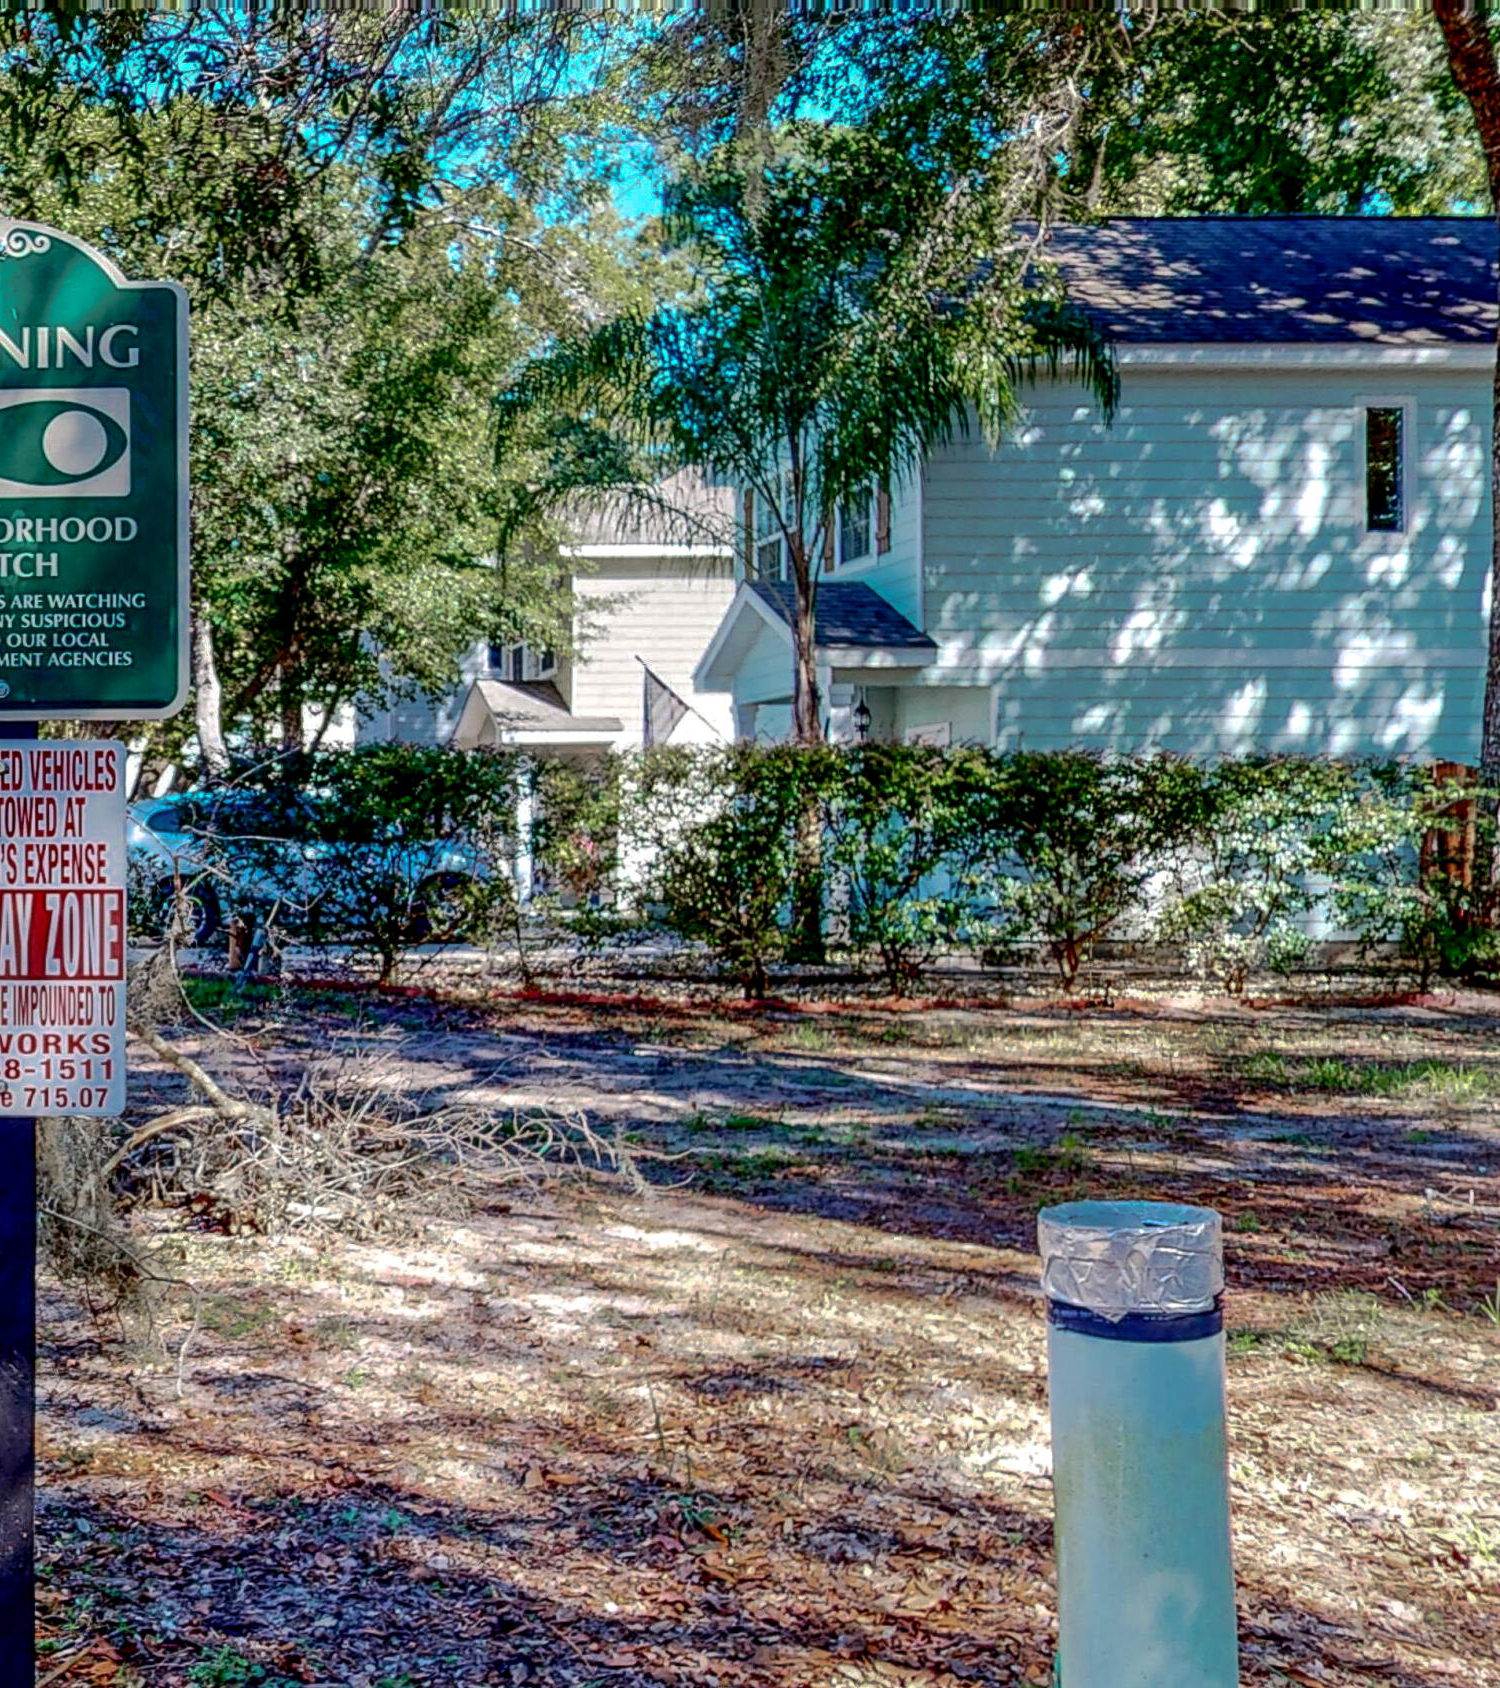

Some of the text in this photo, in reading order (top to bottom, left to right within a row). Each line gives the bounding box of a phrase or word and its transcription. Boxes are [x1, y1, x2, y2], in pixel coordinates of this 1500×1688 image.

[10, 594, 43, 609] ARE
[47, 593, 146, 609] WATCHING
[21, 613, 125, 628] SUSPICIOUS
[6, 633, 47, 648] OUR
[52, 633, 109, 647] LOCAL
[47, 652, 133, 667] AGENCIES
[30, 750, 117, 792] VEHICLES
[64, 797, 85, 838] AT
[25, 844, 107, 885] EXPENSE
[45, 892, 119, 977] ZONE
[13, 986, 94, 1026] IMPOUNDED
[99, 986, 115, 1027] TO
[24, 1087, 108, 1108] 715.07
